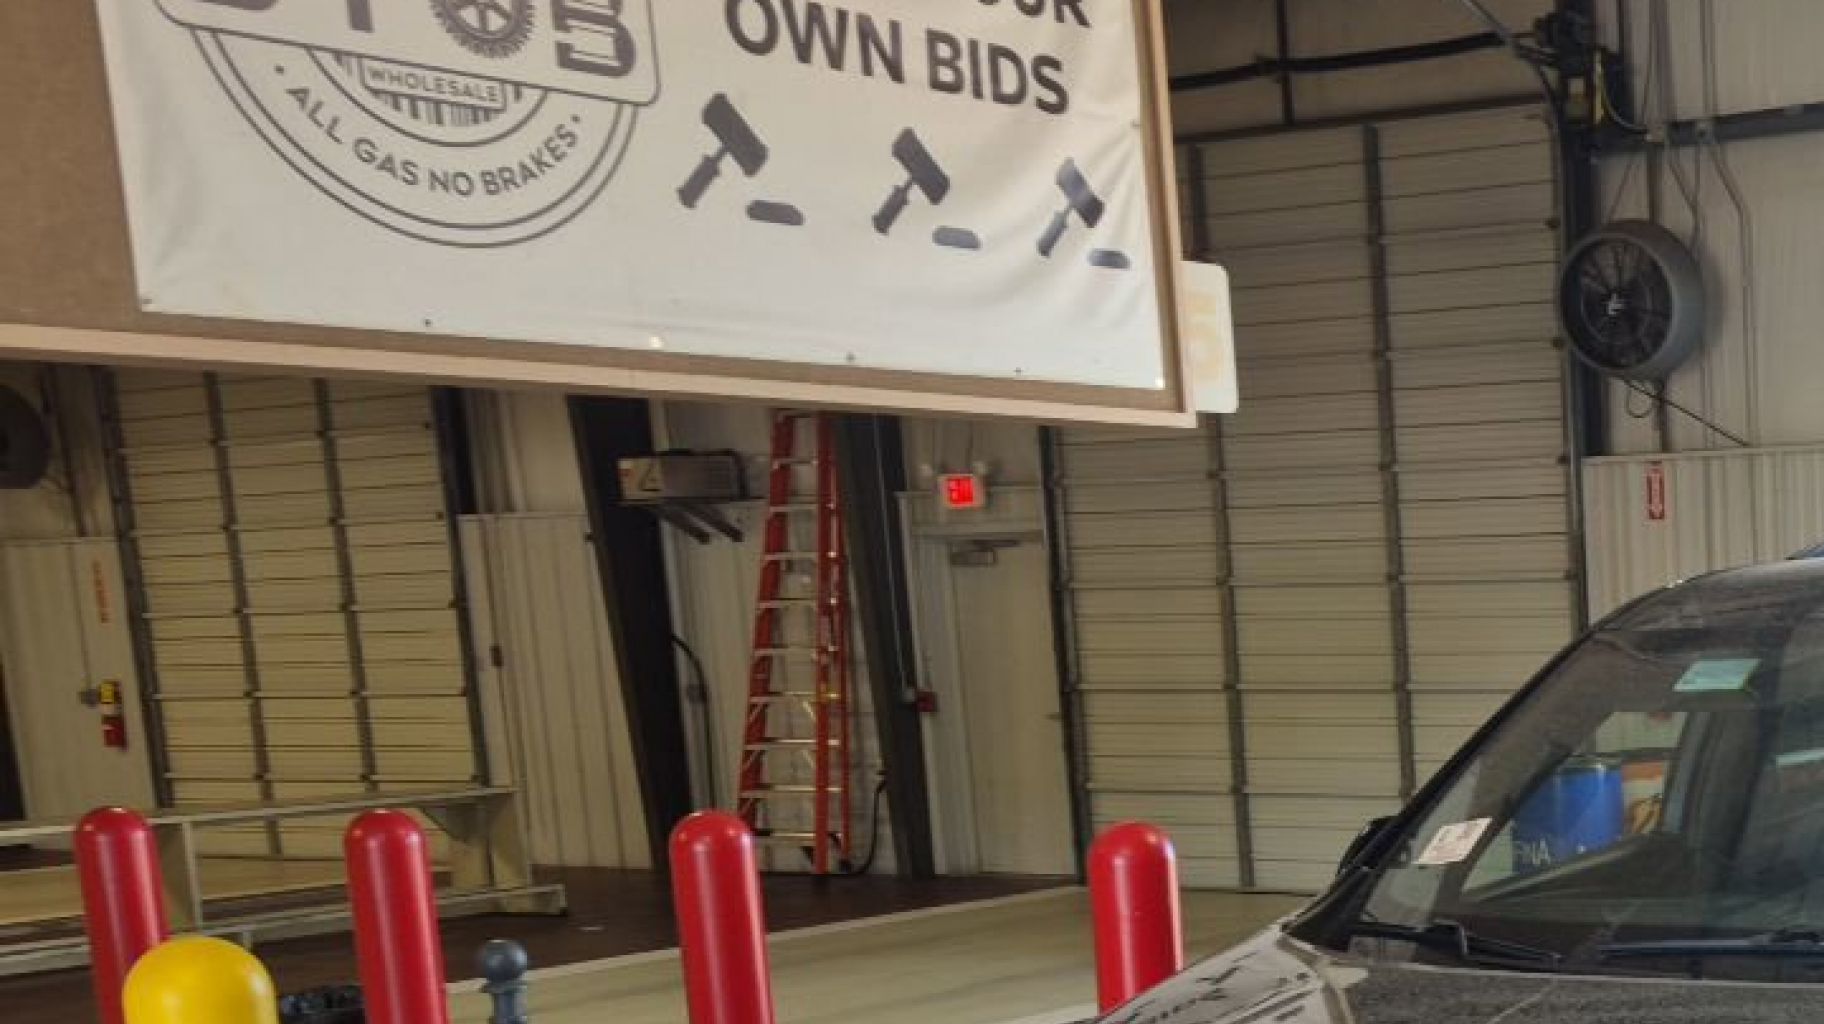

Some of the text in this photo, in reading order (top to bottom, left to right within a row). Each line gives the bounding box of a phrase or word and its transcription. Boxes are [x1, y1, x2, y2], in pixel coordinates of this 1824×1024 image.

[367, 67, 500, 103] WHOLESALE
[726, 0, 1069, 115] OWN BIDS
[285, 86, 580, 197] ALL GAS NO BRAKES
